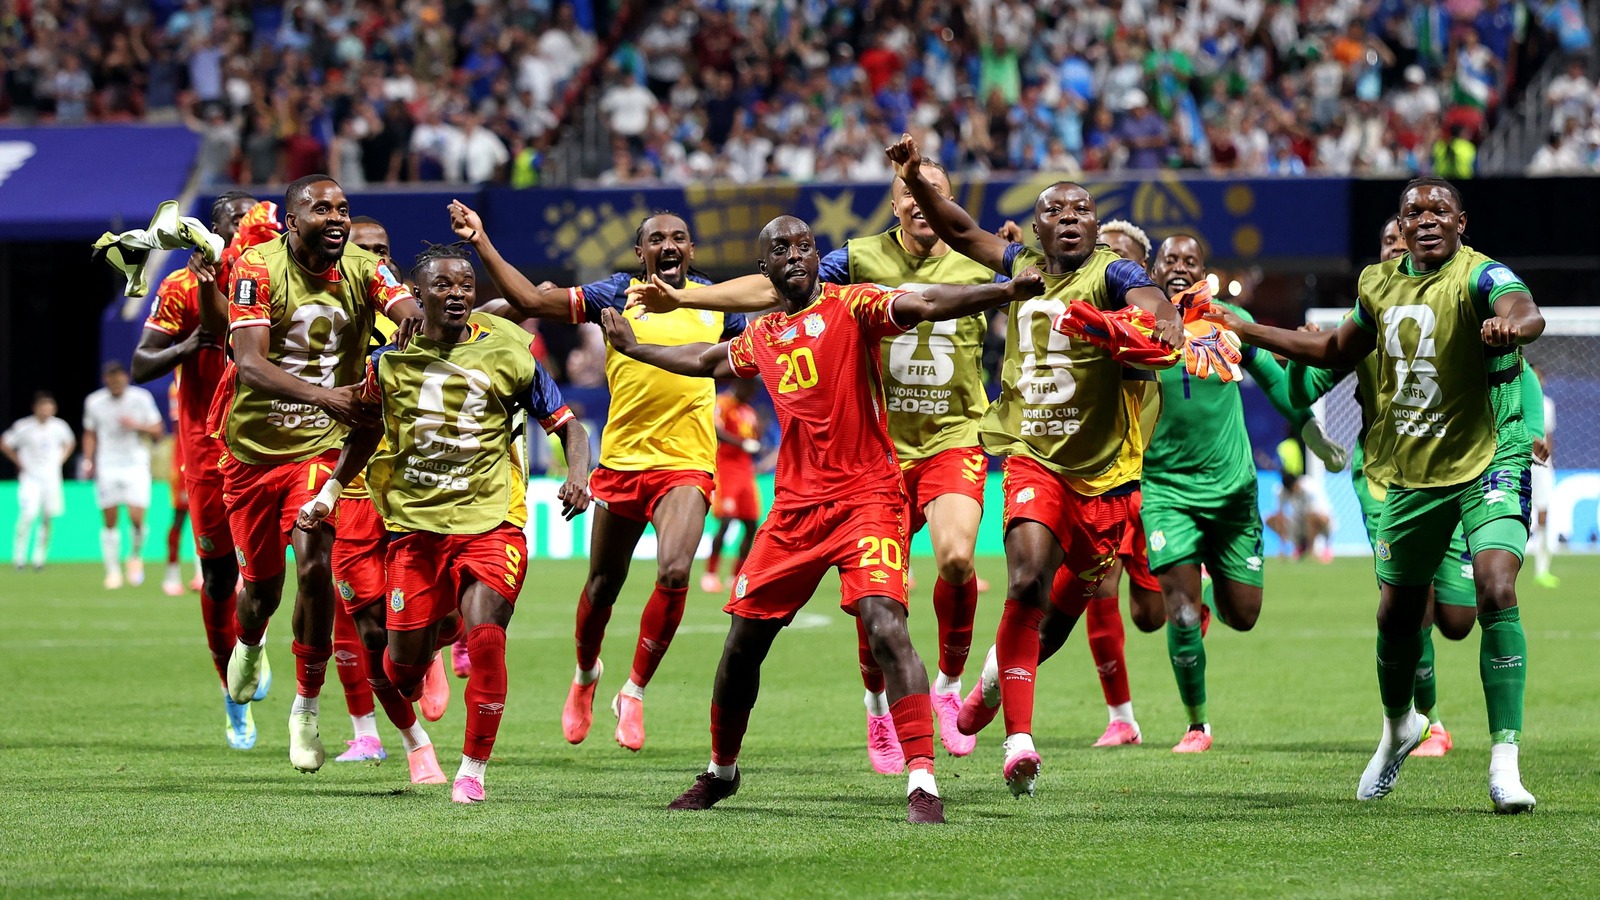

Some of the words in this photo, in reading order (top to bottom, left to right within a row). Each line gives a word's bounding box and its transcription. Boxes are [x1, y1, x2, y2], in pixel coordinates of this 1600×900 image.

[775, 346, 819, 394] 20
[908, 365, 937, 376] FIFA
[889, 386, 929, 398] WORLD
[930, 389, 952, 399] CUP
[1030, 382, 1059, 394] FIFA
[271, 400, 312, 413] WORLD
[888, 396, 950, 415] 2026
[1022, 407, 1054, 419] WORLD
[1055, 407, 1079, 418] CUP
[267, 412, 330, 429] 2026
[1392, 409, 1423, 421] WORLD
[1425, 412, 1446, 422] CUP
[1020, 419, 1080, 437] 2026
[1394, 419, 1447, 438] 2026
[431, 440, 460, 453] FIFA
[407, 455, 449, 472] WORLD
[450, 465, 473, 476] CUP
[403, 467, 469, 491] 2026
[857, 535, 902, 571] 20
